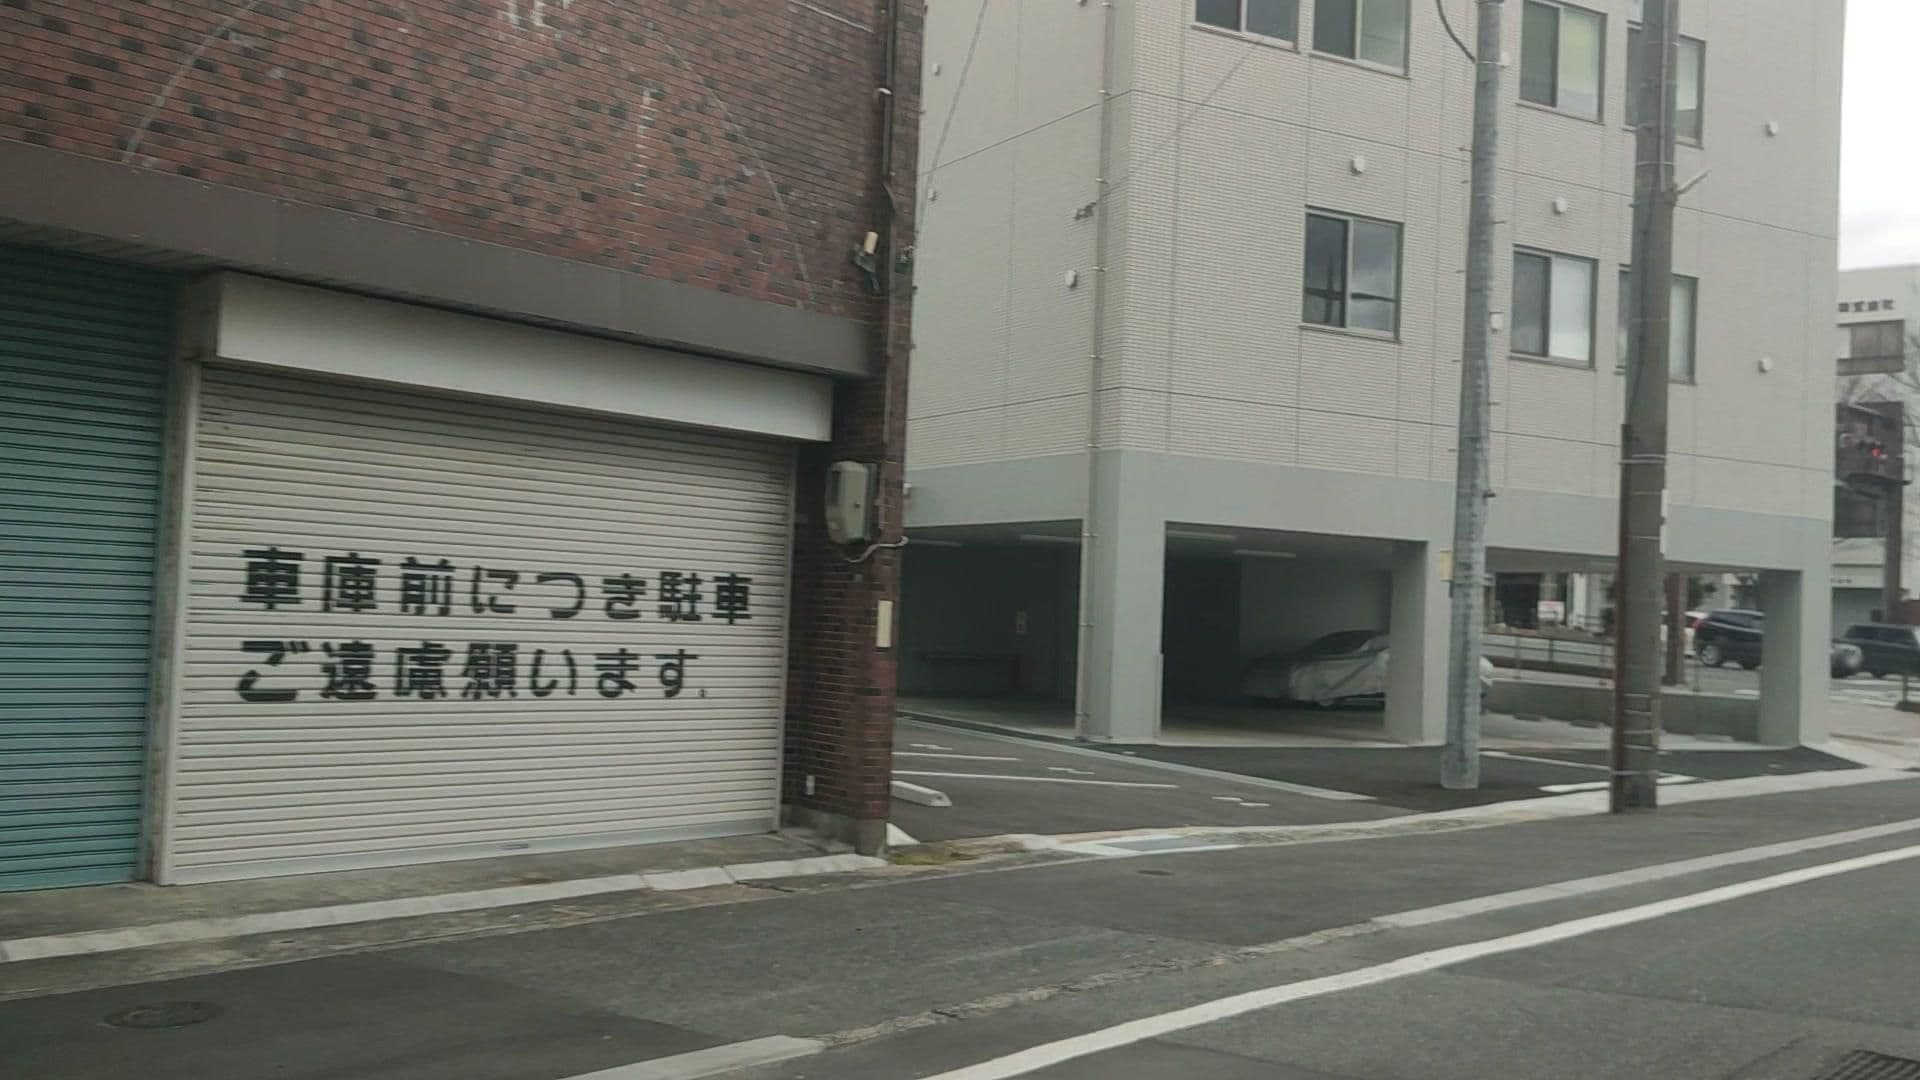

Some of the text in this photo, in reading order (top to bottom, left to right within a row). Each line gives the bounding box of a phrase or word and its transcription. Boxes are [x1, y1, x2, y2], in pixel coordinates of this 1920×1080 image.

[241, 546, 752, 624] 車庫前につき駐車
[237, 641, 707, 702] ご遠慮願います。
